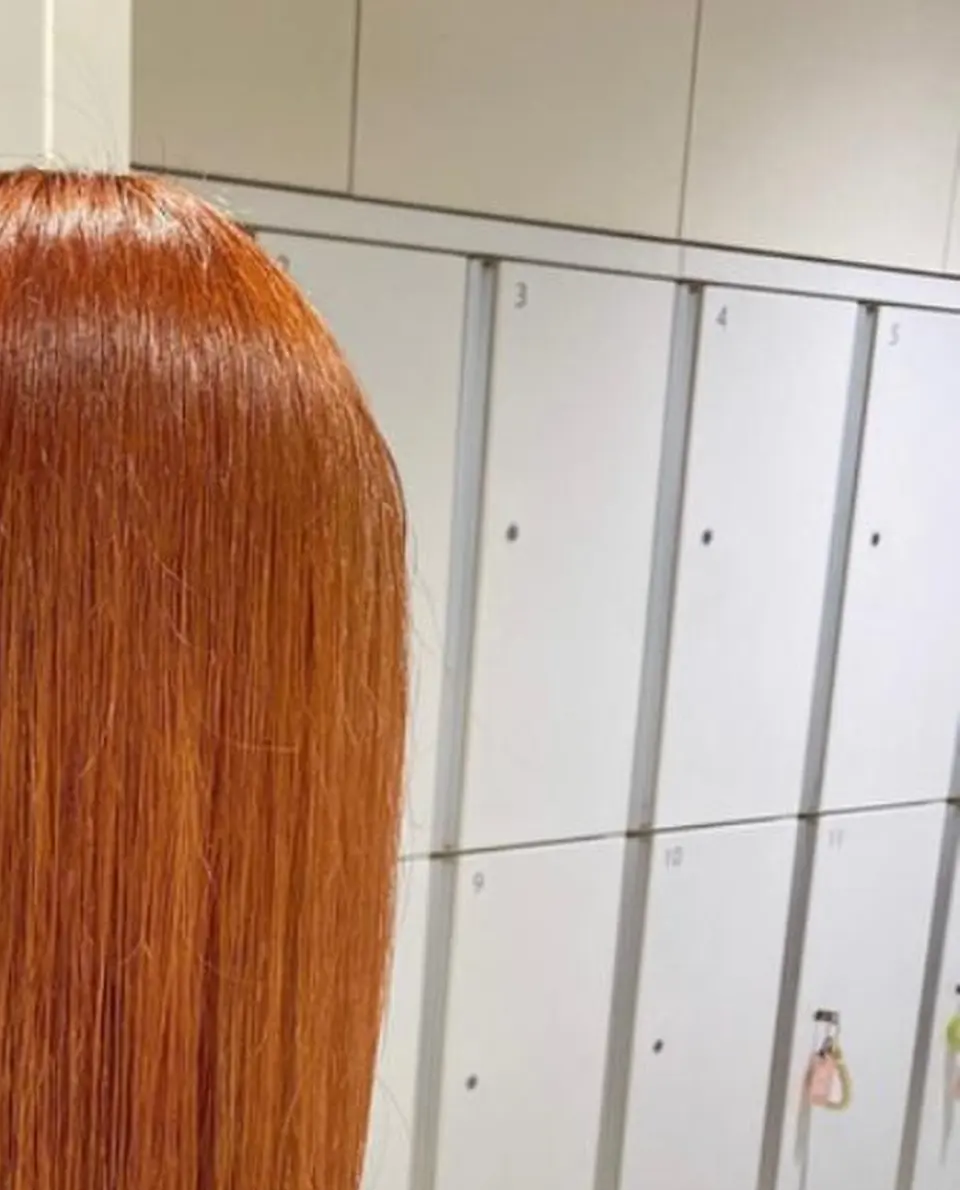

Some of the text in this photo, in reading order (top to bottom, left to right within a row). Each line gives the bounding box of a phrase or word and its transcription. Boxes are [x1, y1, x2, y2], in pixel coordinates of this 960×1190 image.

[513, 281, 528, 309] 3
[715, 304, 728, 332] 4
[888, 322, 901, 347] 5
[471, 871, 485, 896] 9
